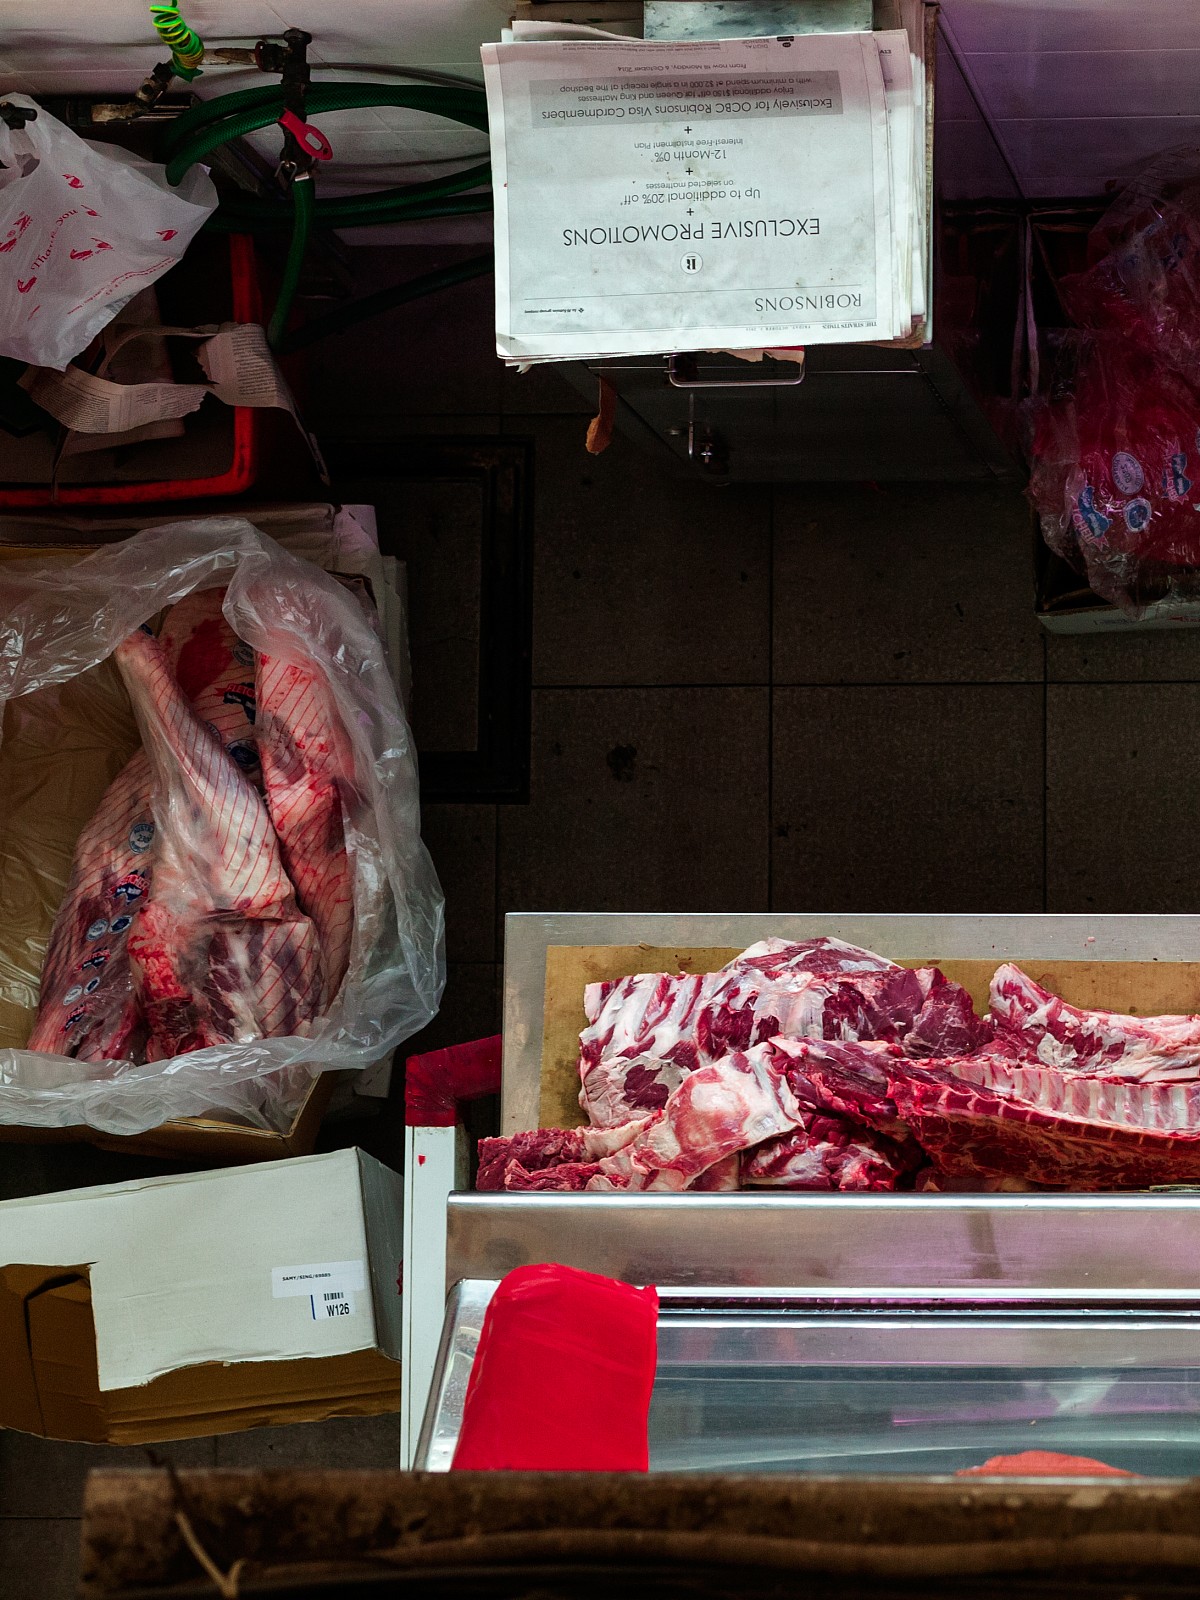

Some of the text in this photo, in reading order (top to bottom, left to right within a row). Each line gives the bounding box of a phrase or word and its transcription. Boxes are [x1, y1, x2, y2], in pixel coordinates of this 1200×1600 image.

[560, 85, 594, 94] Bedshop
[621, 82, 648, 91] receipt
[650, 81, 672, 90] single
[620, 92, 636, 101] King
[656, 91, 684, 100] Queen
[542, 99, 832, 120] Exclusively for OCBC Robinsons Visa Cardmembers
[653, 140, 694, 149] Installment
[674, 150, 727, 160] 12-Month
[668, 191, 726, 202] additional
[730, 190, 740, 199] to
[745, 188, 760, 198] Up
[642, 194, 664, 204] 20%
[56, 208, 78, 226] you
[563, 218, 819, 246] EXCLUSIVE PROMOTIONS
[755, 294, 861, 312] ROBINSONS
[326, 1302, 350, 1317] W126
